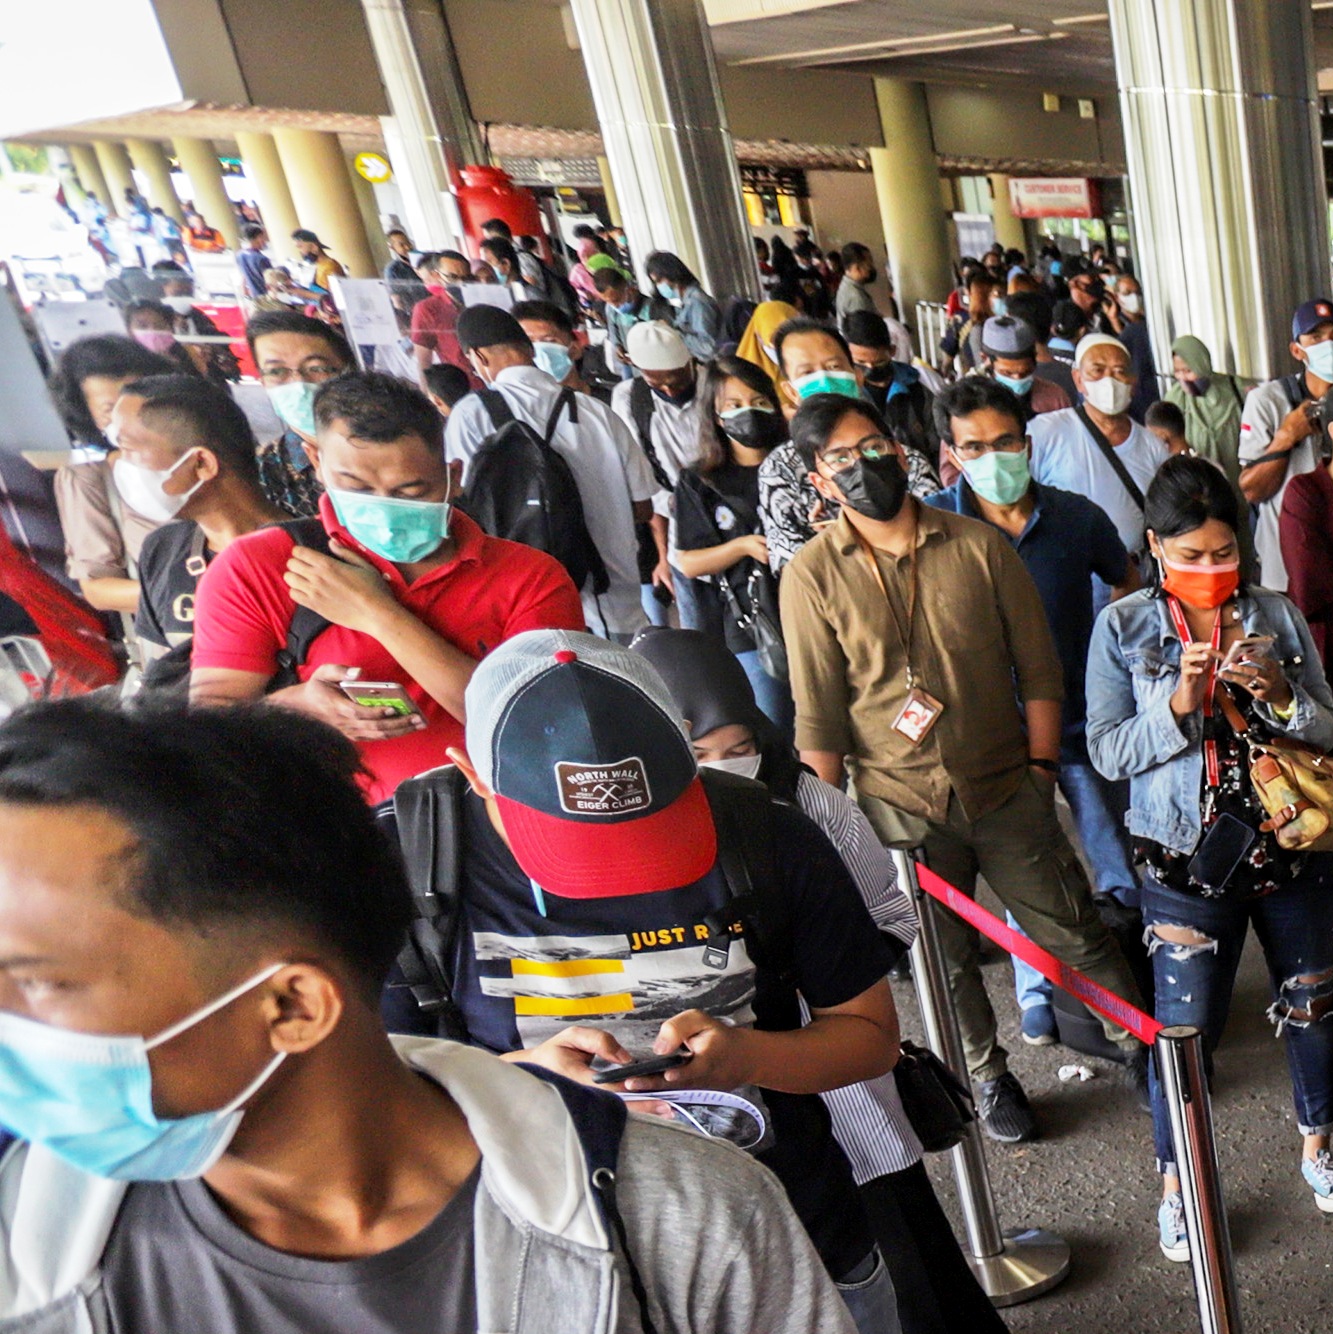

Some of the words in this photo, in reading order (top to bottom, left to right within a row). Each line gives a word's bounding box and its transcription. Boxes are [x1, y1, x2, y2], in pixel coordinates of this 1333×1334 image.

[567, 770, 608, 784] NORTH
[611, 769, 639, 780] WALL
[577, 801, 609, 809] EIGER
[612, 796, 642, 808] CLIMB
[631, 927, 686, 950] JUST
